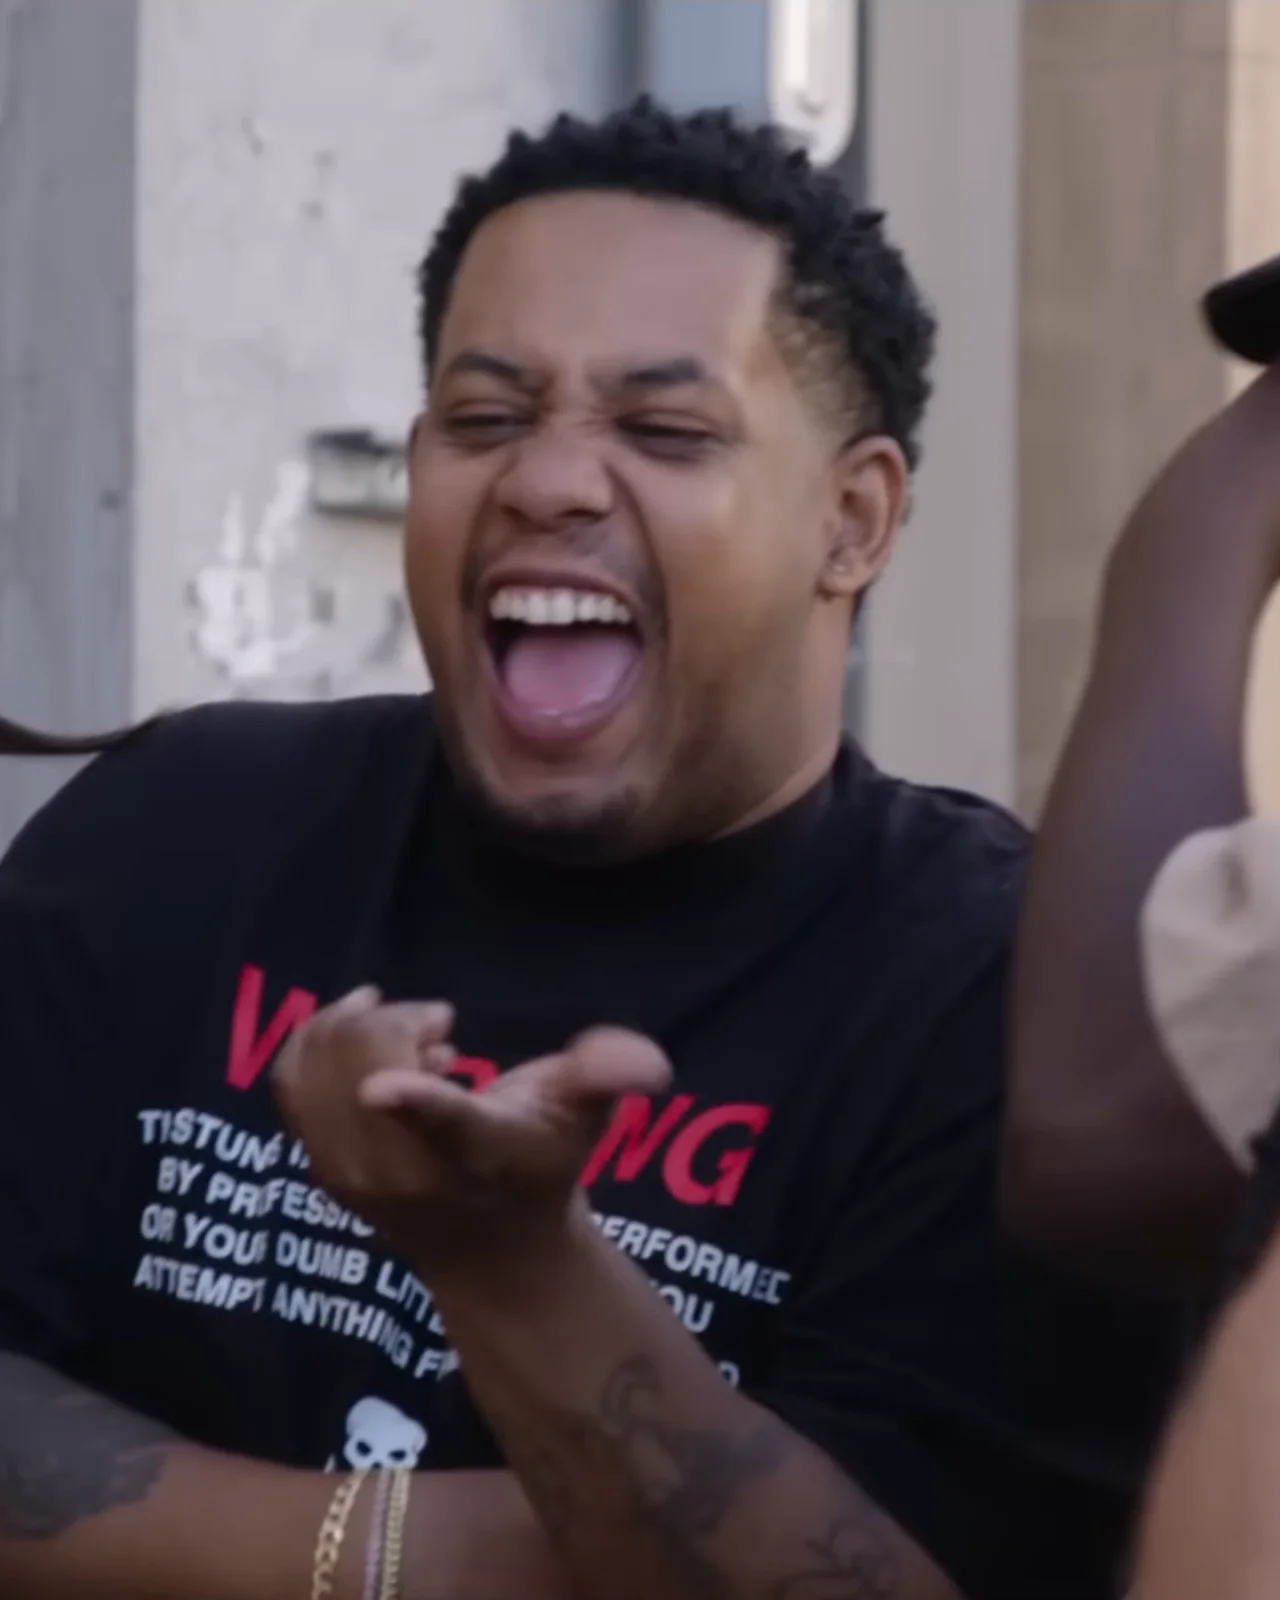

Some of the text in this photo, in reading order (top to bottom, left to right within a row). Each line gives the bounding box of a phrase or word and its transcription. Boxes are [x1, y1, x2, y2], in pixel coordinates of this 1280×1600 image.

[157, 1156, 204, 1196] BY
[140, 1204, 177, 1242] OR
[275, 1231, 370, 1285] DUMB
[272, 1282, 414, 1368] ANYTHING
